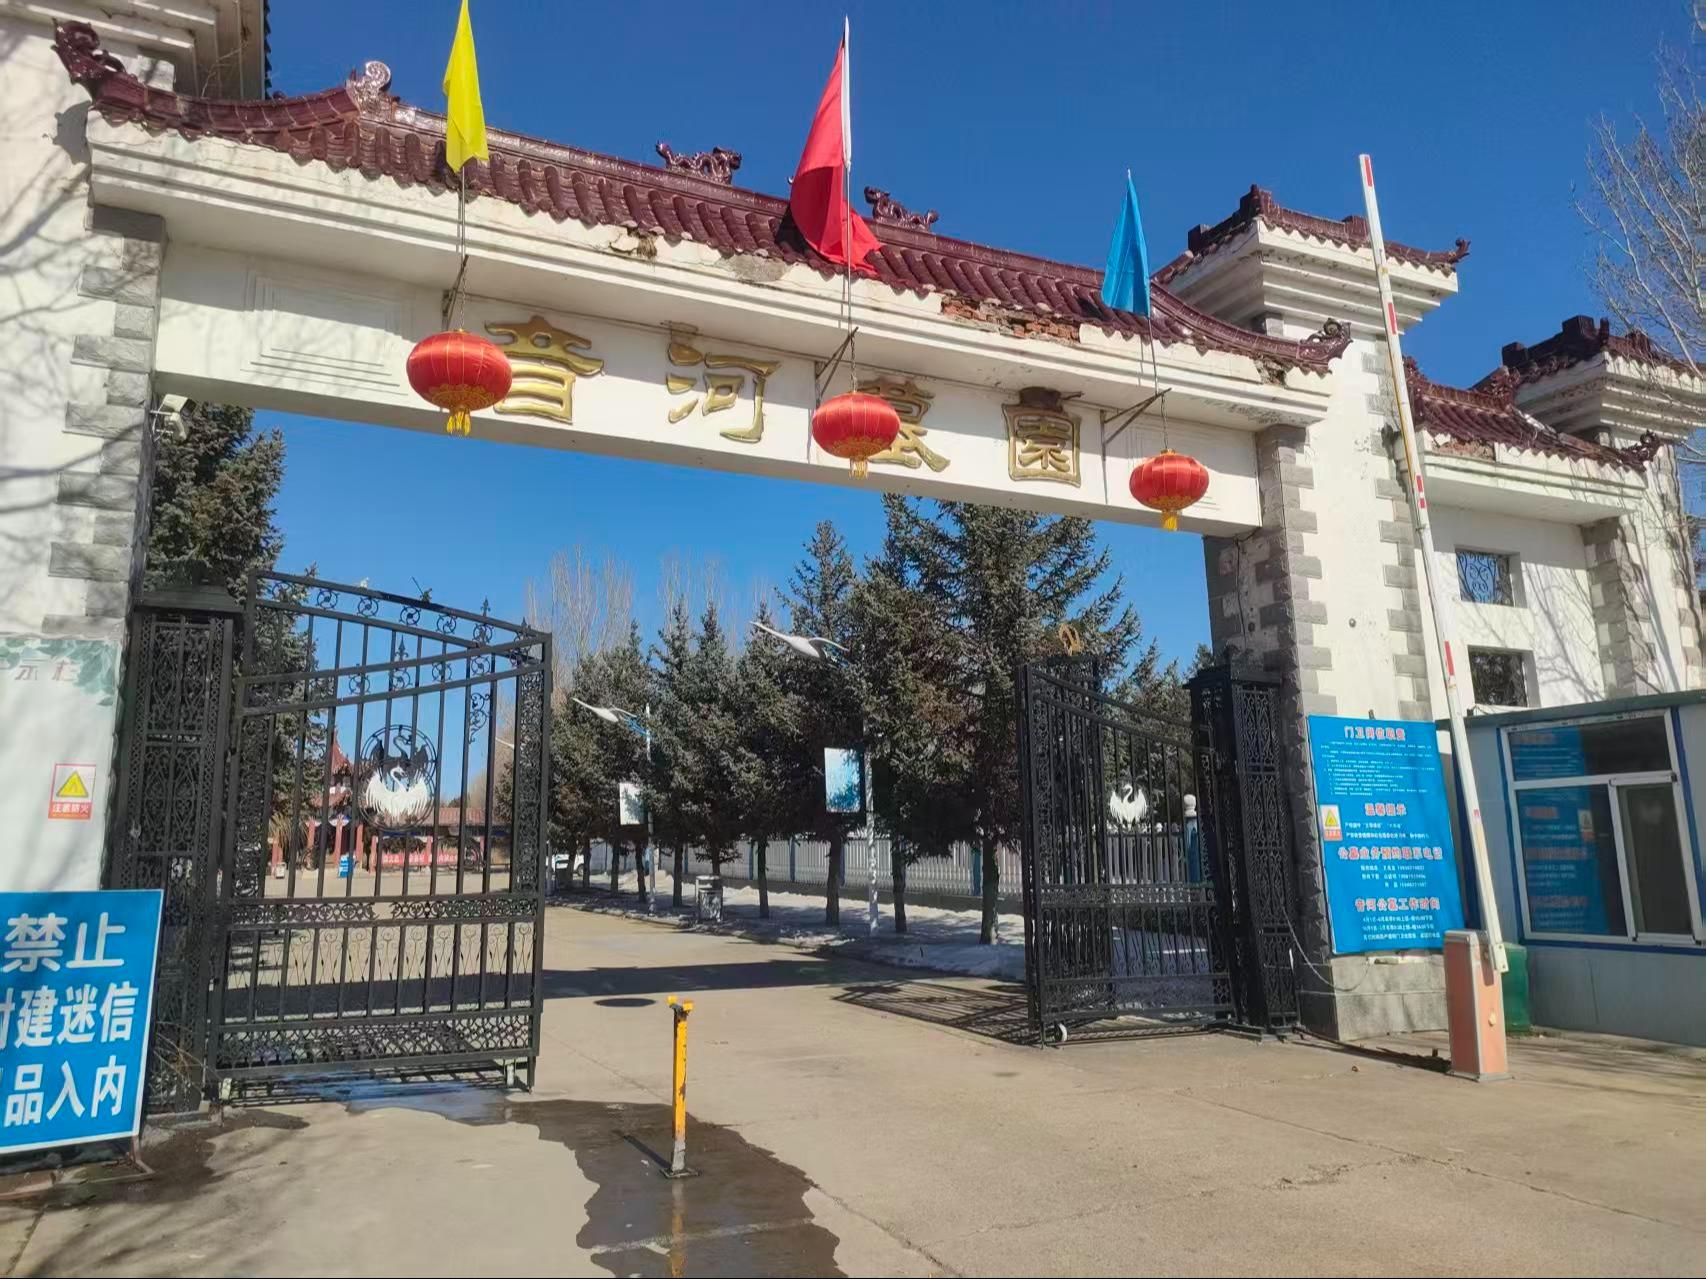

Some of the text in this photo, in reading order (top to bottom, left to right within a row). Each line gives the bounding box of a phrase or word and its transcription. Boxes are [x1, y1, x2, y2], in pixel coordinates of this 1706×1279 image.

[3, 912, 126, 973] 禁止
[0, 1055, 127, 1127] 品入内
